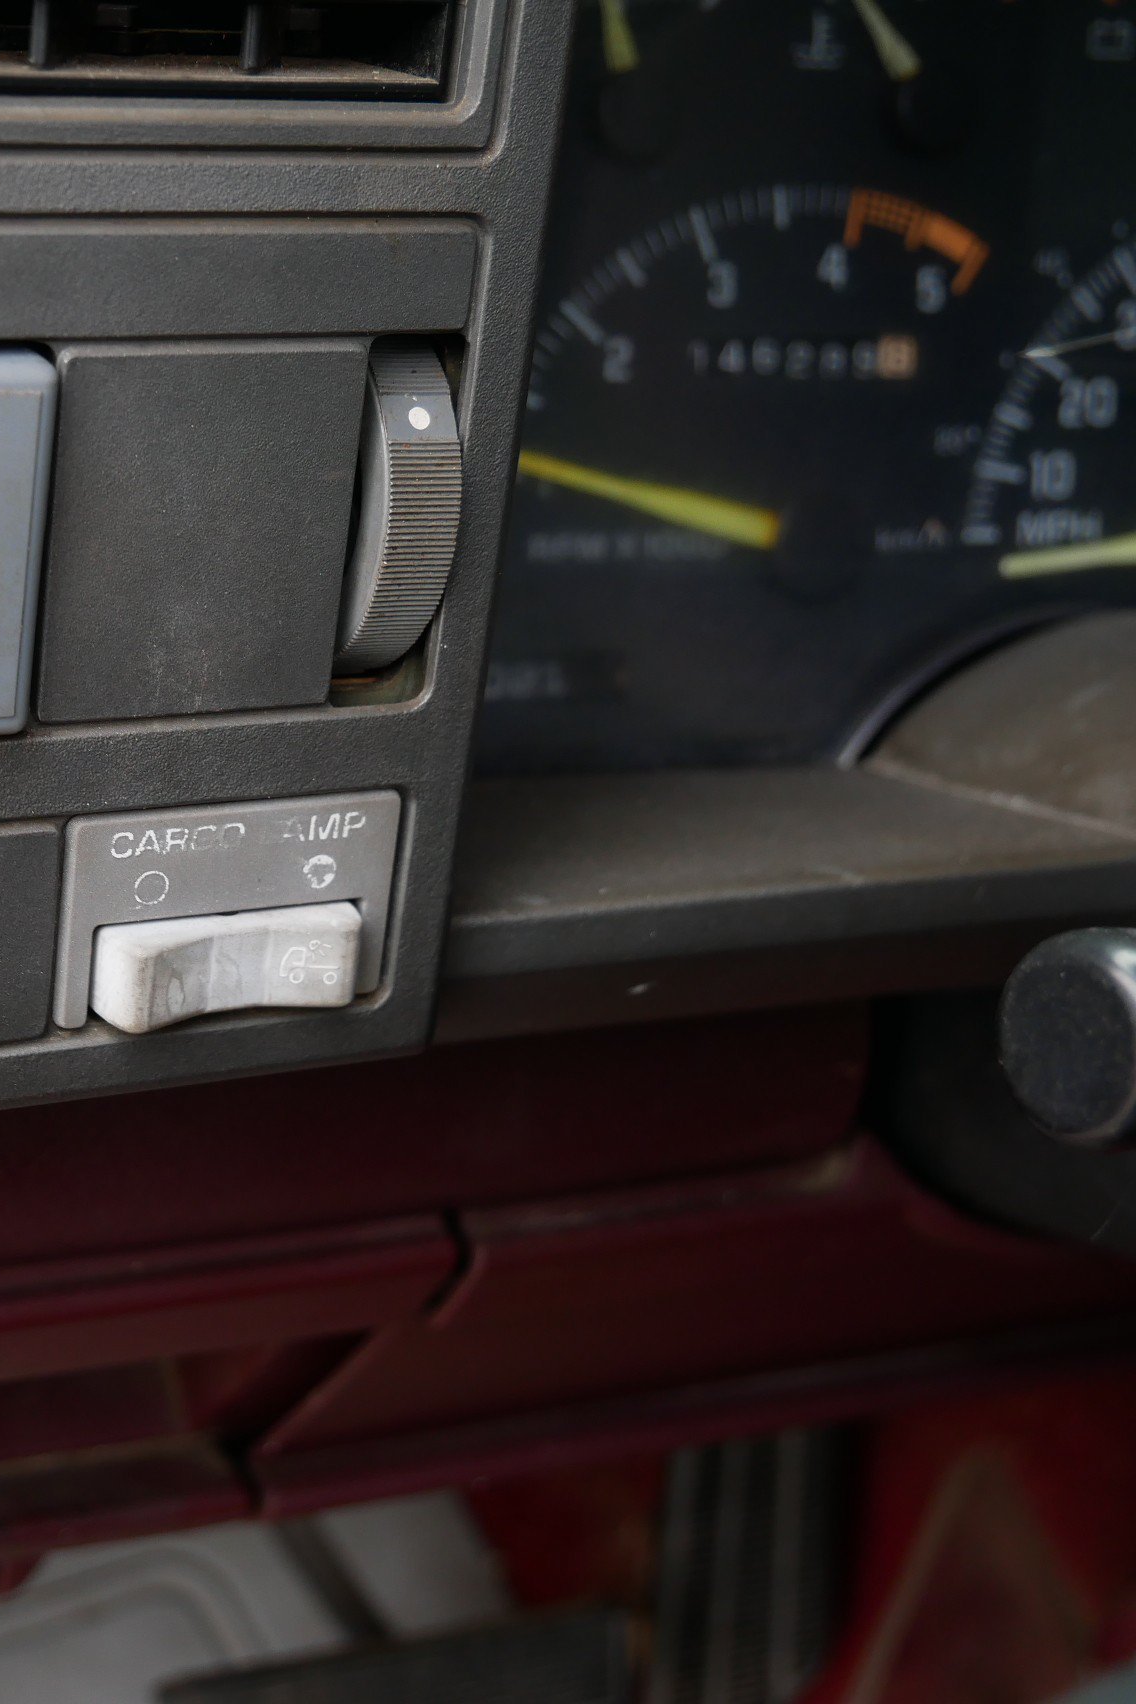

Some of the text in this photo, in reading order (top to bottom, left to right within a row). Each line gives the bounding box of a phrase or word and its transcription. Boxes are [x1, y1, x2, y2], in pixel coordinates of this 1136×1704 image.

[707, 257, 739, 309] 3
[1029, 448, 1077, 500] 10
[1016, 510, 1102, 547] MPH
[276, 811, 366, 842] AMP
